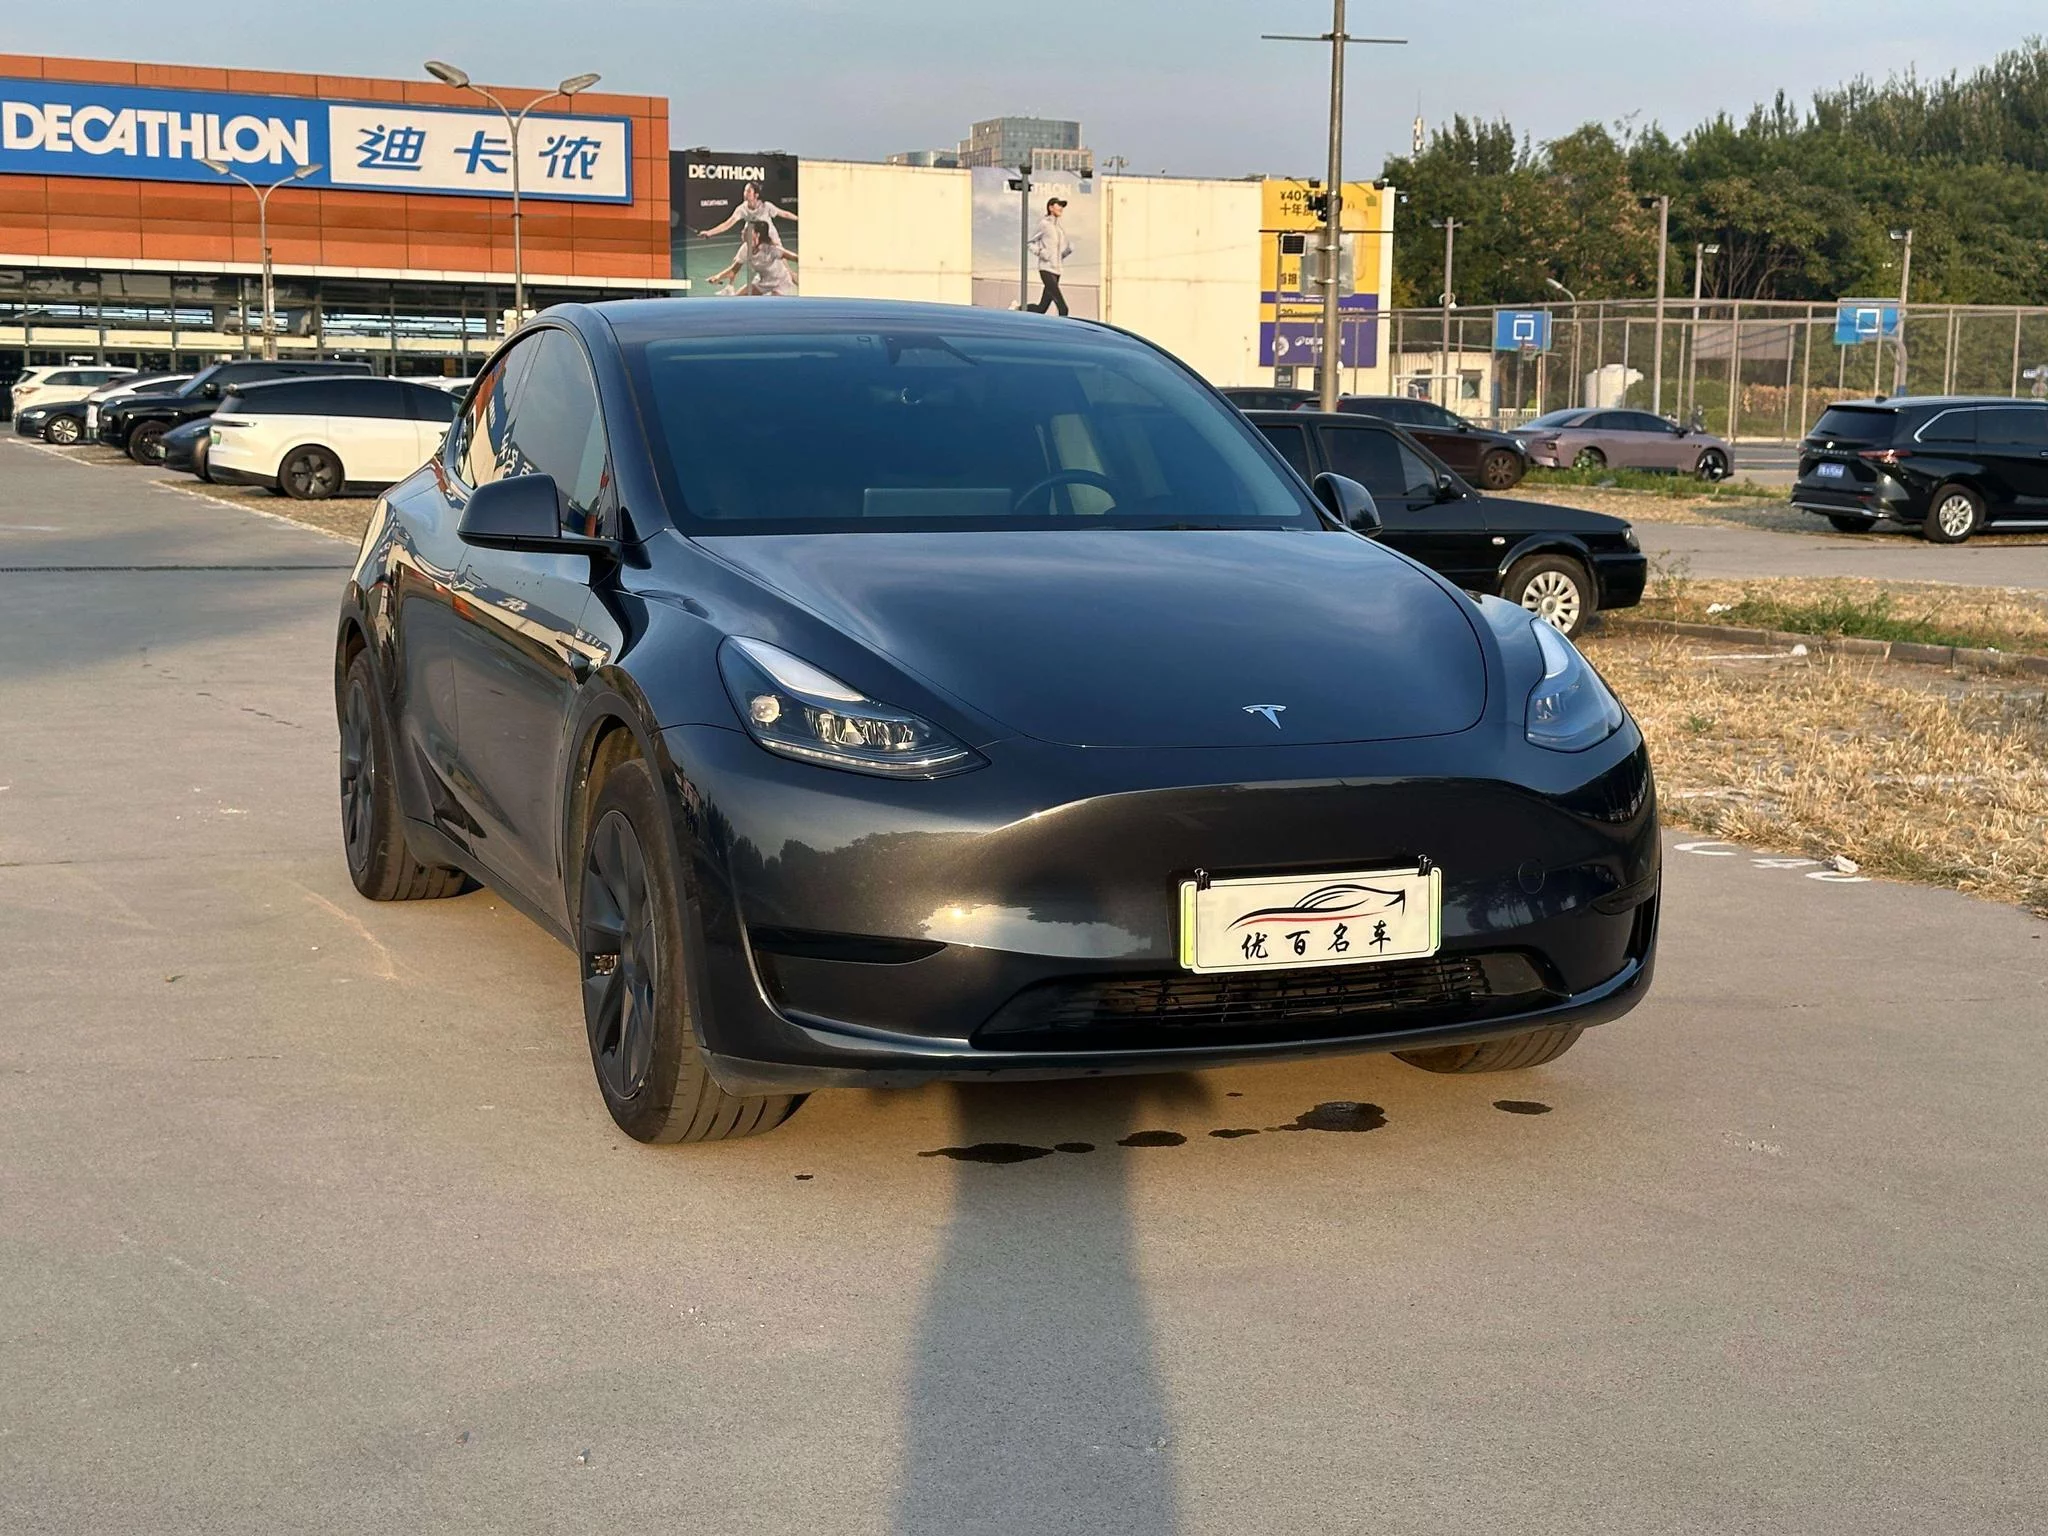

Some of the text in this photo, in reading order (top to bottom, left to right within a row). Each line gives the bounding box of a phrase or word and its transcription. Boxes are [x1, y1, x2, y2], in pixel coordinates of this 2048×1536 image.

[2, 100, 309, 166] DECATHLON
[356, 124, 602, 180] 迪卡侬
[688, 164, 765, 181] DECATHLON
[1241, 919, 1391, 959] 优百名车
